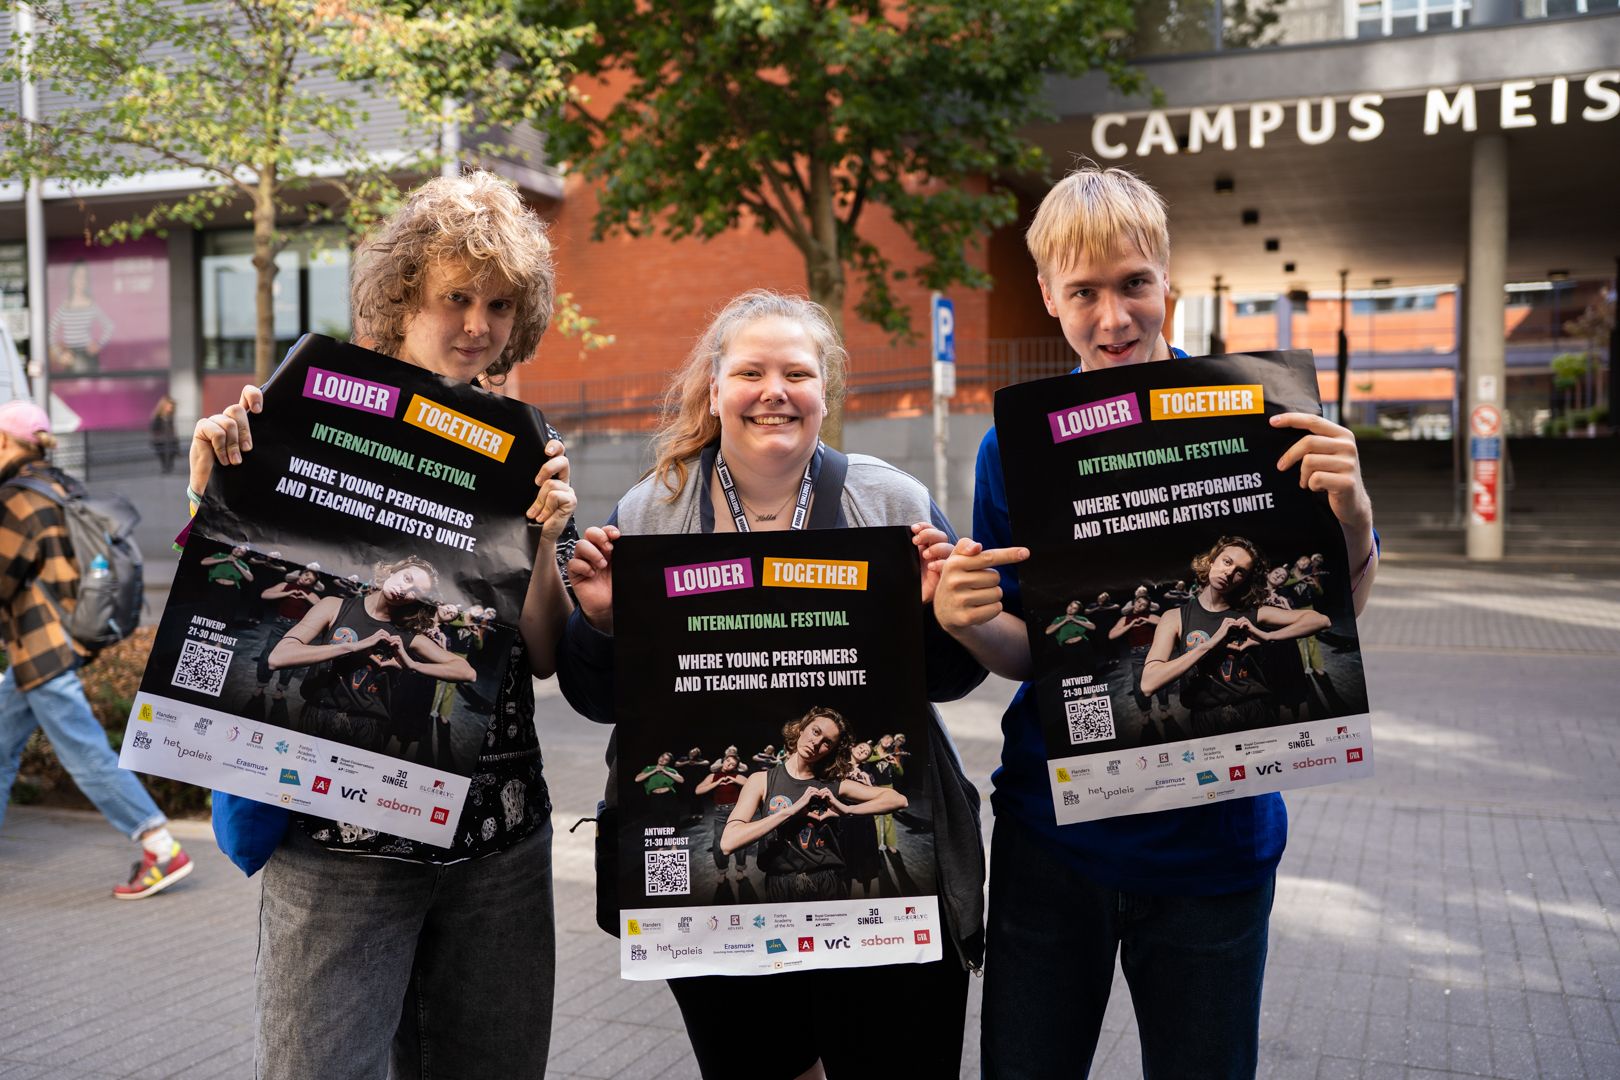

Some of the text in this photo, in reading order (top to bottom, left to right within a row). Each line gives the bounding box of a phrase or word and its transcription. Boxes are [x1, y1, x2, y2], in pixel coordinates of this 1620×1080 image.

[1091, 69, 1620, 159] CAMPUS MEIS
[938, 306, 954, 353] P
[313, 374, 503, 454] LOUDER TOGETHER
[1056, 390, 1253, 438] LOUDER TOGETHER
[311, 422, 476, 491] INTERNATIONAL FESTIVAL
[1078, 437, 1249, 476] INTERNATIONAL FESTIVAL
[289, 456, 475, 529] WHERE YOUNG PERFORMERS
[1073, 473, 1262, 517] WHERE YOUNG PERFORMERS
[275, 476, 477, 553] AND TEACHING ARTISTS UNITE
[1073, 493, 1275, 540] AND TEACHING ARTISTS UNITE
[673, 562, 858, 592] LOUDER TOGETHER
[191, 615, 226, 630] ANTWERP
[687, 610, 849, 631] INTERNATIONAL FESTIVAL
[188, 626, 238, 646] 21-30 AUGUST
[678, 648, 858, 670] WHERE YOUNG PERFORMERS
[674, 669, 866, 692] AND TEACHING ARTISTS UNITE
[1062, 675, 1093, 687] ANTWERP
[1063, 683, 1108, 698] 21-30 AUGUST
[1288, 739, 1315, 750] SINGEL
[1293, 755, 1337, 769] sabam
[381, 775, 408, 789] SINGEL
[376, 798, 422, 817] sabam
[644, 827, 675, 836] ANTWERP
[644, 836, 689, 847] 21-30 AUGUST
[857, 916, 884, 925] SINGEL
[824, 936, 851, 949] vrt
[861, 935, 904, 947] sabam
[657, 944, 672, 952] het
[672, 947, 703, 959] paleis
